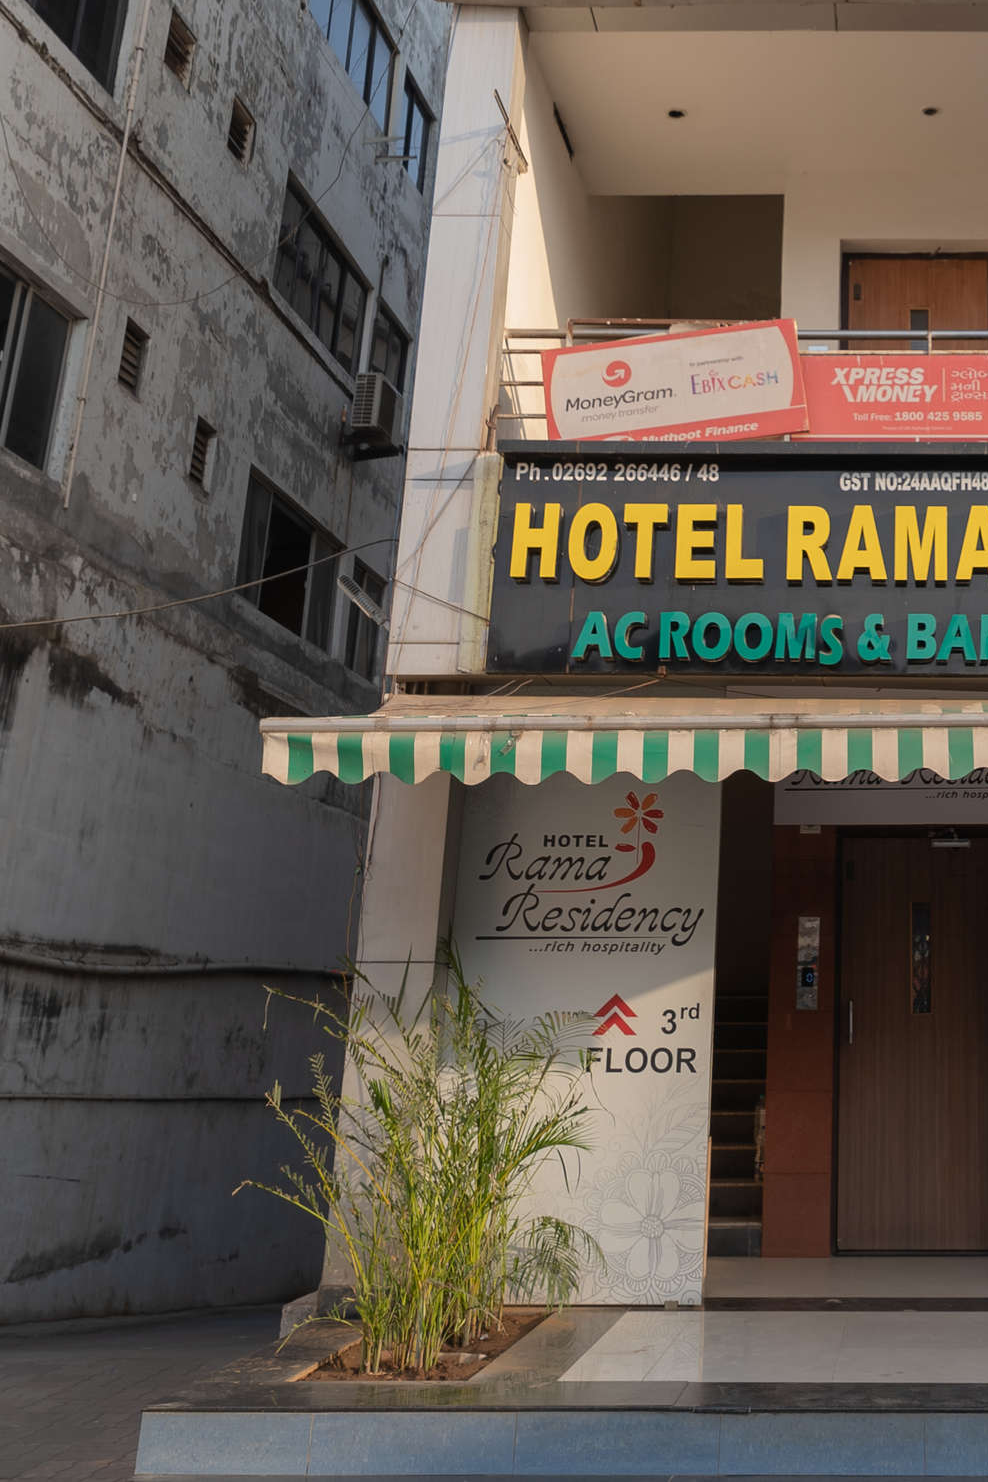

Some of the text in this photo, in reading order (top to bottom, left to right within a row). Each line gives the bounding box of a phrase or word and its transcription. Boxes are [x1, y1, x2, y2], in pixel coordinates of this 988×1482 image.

[832, 367, 925, 385] XPRESS
[566, 386, 673, 413] MoneyGram
[847, 385, 938, 403] MONEY
[581, 404, 660, 422] money transfer
[853, 412, 869, 421] Toll
[894, 411, 924, 422] 1800
[927, 411, 949, 422] 425
[952, 411, 983, 422] 9585
[705, 421, 760, 437] Finance
[613, 463, 681, 482] 266446
[685, 463, 692, 482] /
[697, 464, 719, 482] 48
[839, 472, 871, 491] GST
[509, 502, 765, 582] HOTEL
[571, 610, 649, 661] AC
[658, 611, 844, 665] ROOMS
[857, 613, 892, 662] &
[543, 835, 609, 848] HOTEL
[478, 833, 612, 882] Rama
[495, 883, 705, 947] Residency
[580, 940, 666, 955] hospitality
[661, 1003, 700, 1034] 3rd
[585, 1047, 697, 1074] FLOOR
